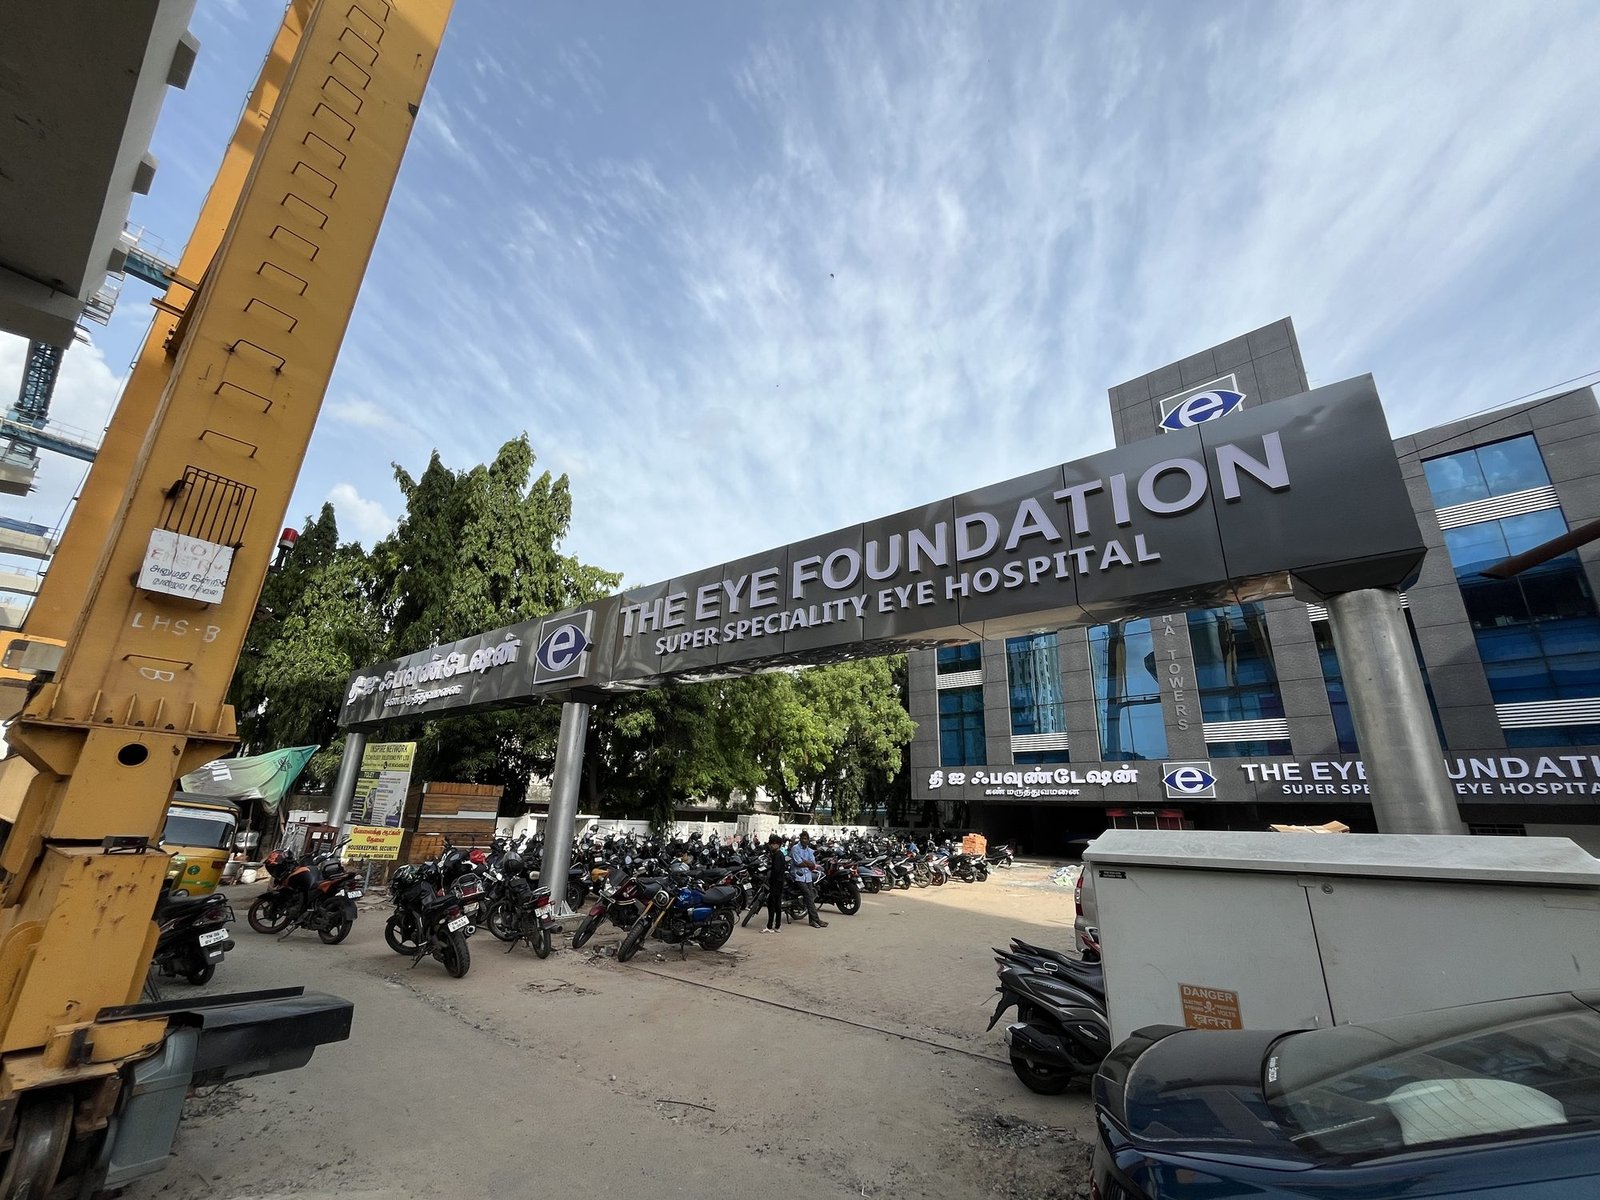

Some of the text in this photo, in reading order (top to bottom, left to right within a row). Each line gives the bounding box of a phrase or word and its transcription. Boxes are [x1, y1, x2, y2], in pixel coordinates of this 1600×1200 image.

[620, 431, 1291, 637] THE EYE FOUNDATION
[655, 534, 1161, 655] SUPER SPECIALITY EYE HOSPITAL
[1168, 649, 1189, 731] TOWERS
[928, 770, 944, 789] தி
[948, 772, 965, 786] ஐ
[1241, 762, 1303, 782] THE
[1282, 784, 1337, 795] SUPER
[1456, 783, 1494, 794] EYE
[1499, 782, 1600, 795] HOSPITA
[1183, 986, 1234, 1003] DANGER
